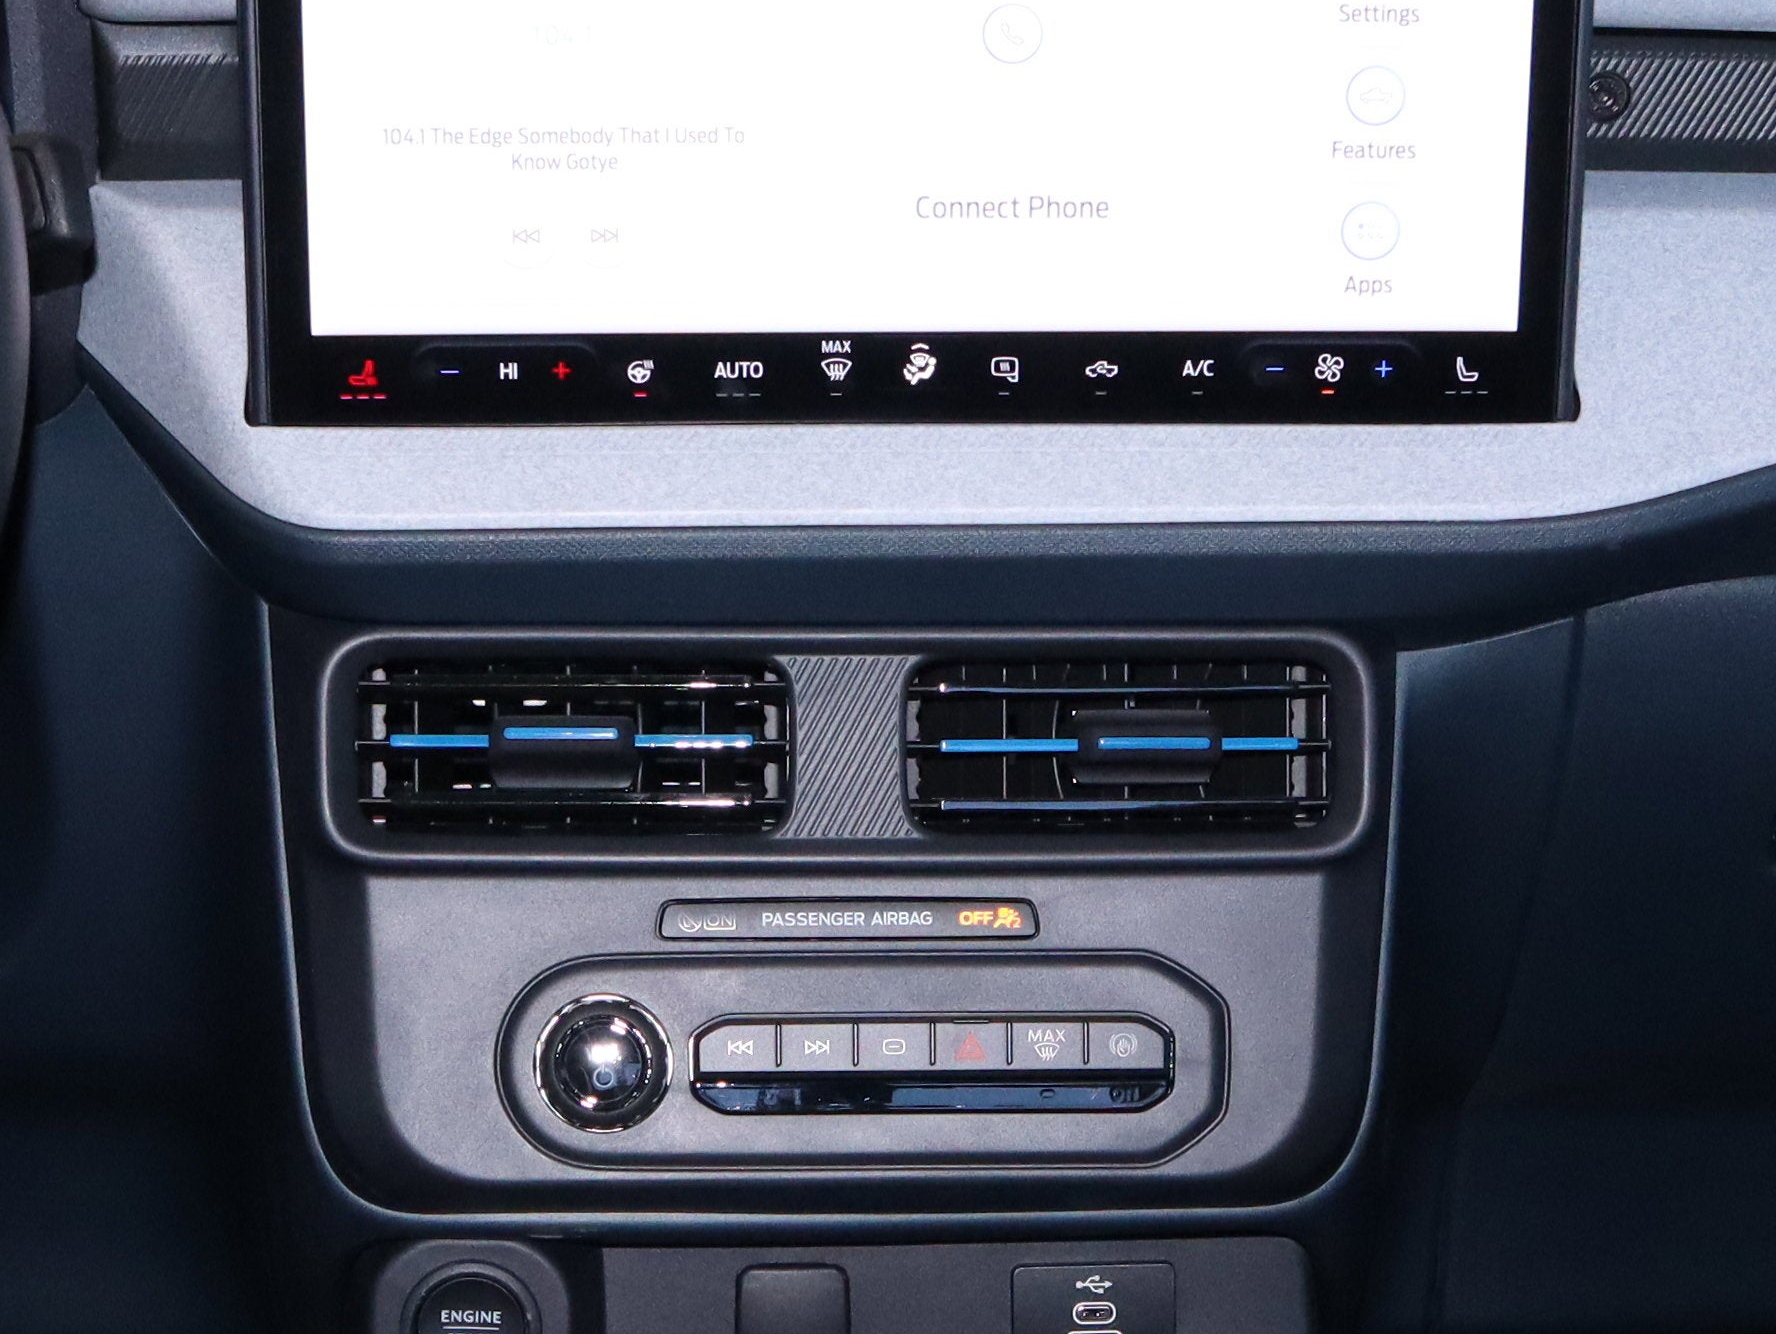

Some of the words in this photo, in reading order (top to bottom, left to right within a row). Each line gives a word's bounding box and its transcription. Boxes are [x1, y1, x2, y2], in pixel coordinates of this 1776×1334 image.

[1339, 3, 1420, 28] Settings
[383, 127, 425, 146] 104.1
[430, 127, 464, 145] The
[469, 127, 513, 148] Edge
[517, 127, 614, 148] Somebody
[618, 126, 660, 144] That
[675, 126, 719, 144] Used
[724, 126, 745, 144] To
[1331, 140, 1416, 159] Features
[511, 153, 562, 171] Know
[566, 153, 618, 174] Gotye
[915, 195, 1020, 219] Connect
[1028, 195, 1109, 219] Phone
[1343, 275, 1393, 297] Apps
[821, 339, 852, 354] MAX
[499, 362, 518, 380] HI
[713, 361, 764, 379] AUTO
[1182, 359, 1215, 377] A/C
[707, 913, 733, 927] ON
[762, 911, 866, 927] PASSENGER
[870, 910, 934, 927] AIRBAG
[958, 910, 994, 926] OFF
[1027, 1029, 1066, 1043] MAX
[440, 1309, 502, 1324] ENGINE
